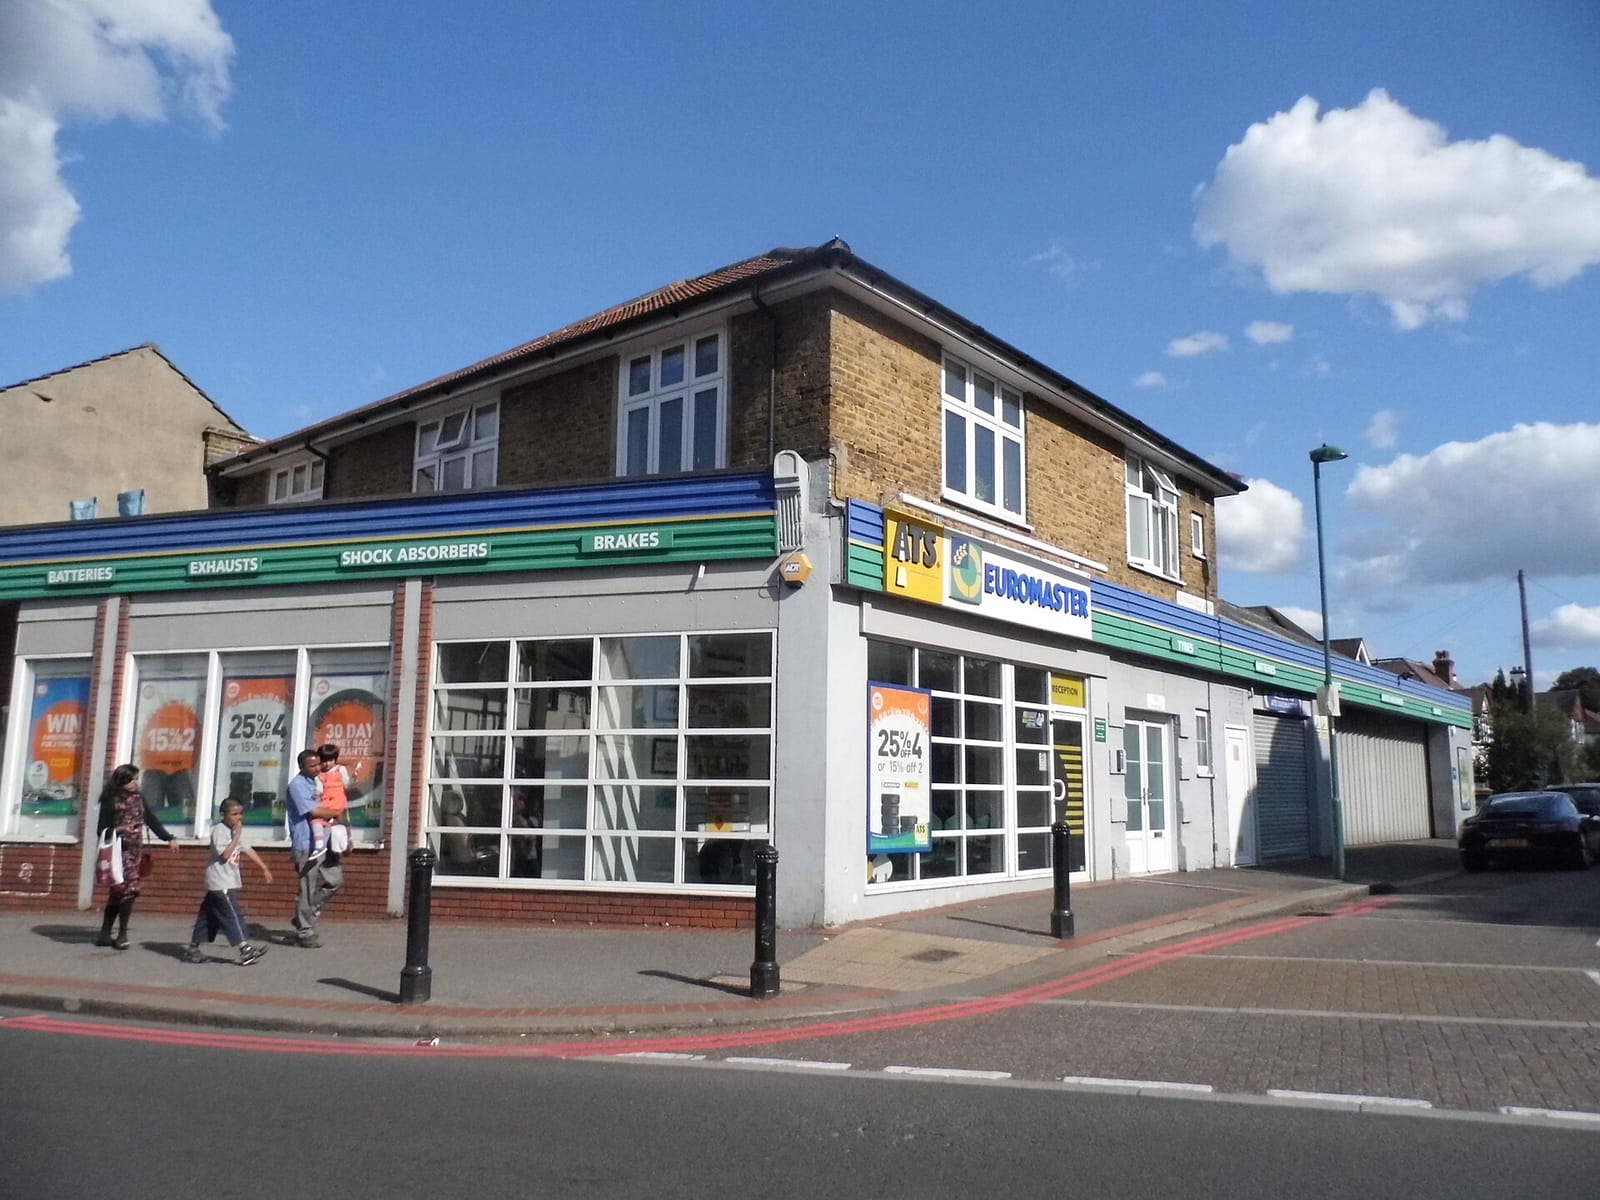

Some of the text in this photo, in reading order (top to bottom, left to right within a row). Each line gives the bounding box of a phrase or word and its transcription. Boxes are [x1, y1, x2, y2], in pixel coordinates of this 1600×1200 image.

[593, 531, 660, 550] BRAKES
[891, 521, 938, 569] ATS
[341, 542, 489, 565] SHOCK ABSORBERS
[47, 566, 113, 584] BATTERIES
[189, 558, 259, 575] EXHAUSTS
[785, 561, 800, 573] ADT
[984, 562, 1089, 619] EUROMASTER
[1052, 684, 1078, 696] RECEPTION
[47, 713, 82, 733] WIN
[229, 713, 288, 739] 25% OFF 4
[326, 722, 376, 738] 30 DAY
[241, 741, 260, 753] 15%
[263, 741, 276, 753] off
[279, 741, 287, 753] 2
[878, 728, 922, 759] 25% OFF 4
[877, 760, 923, 774] or 15% off 2
